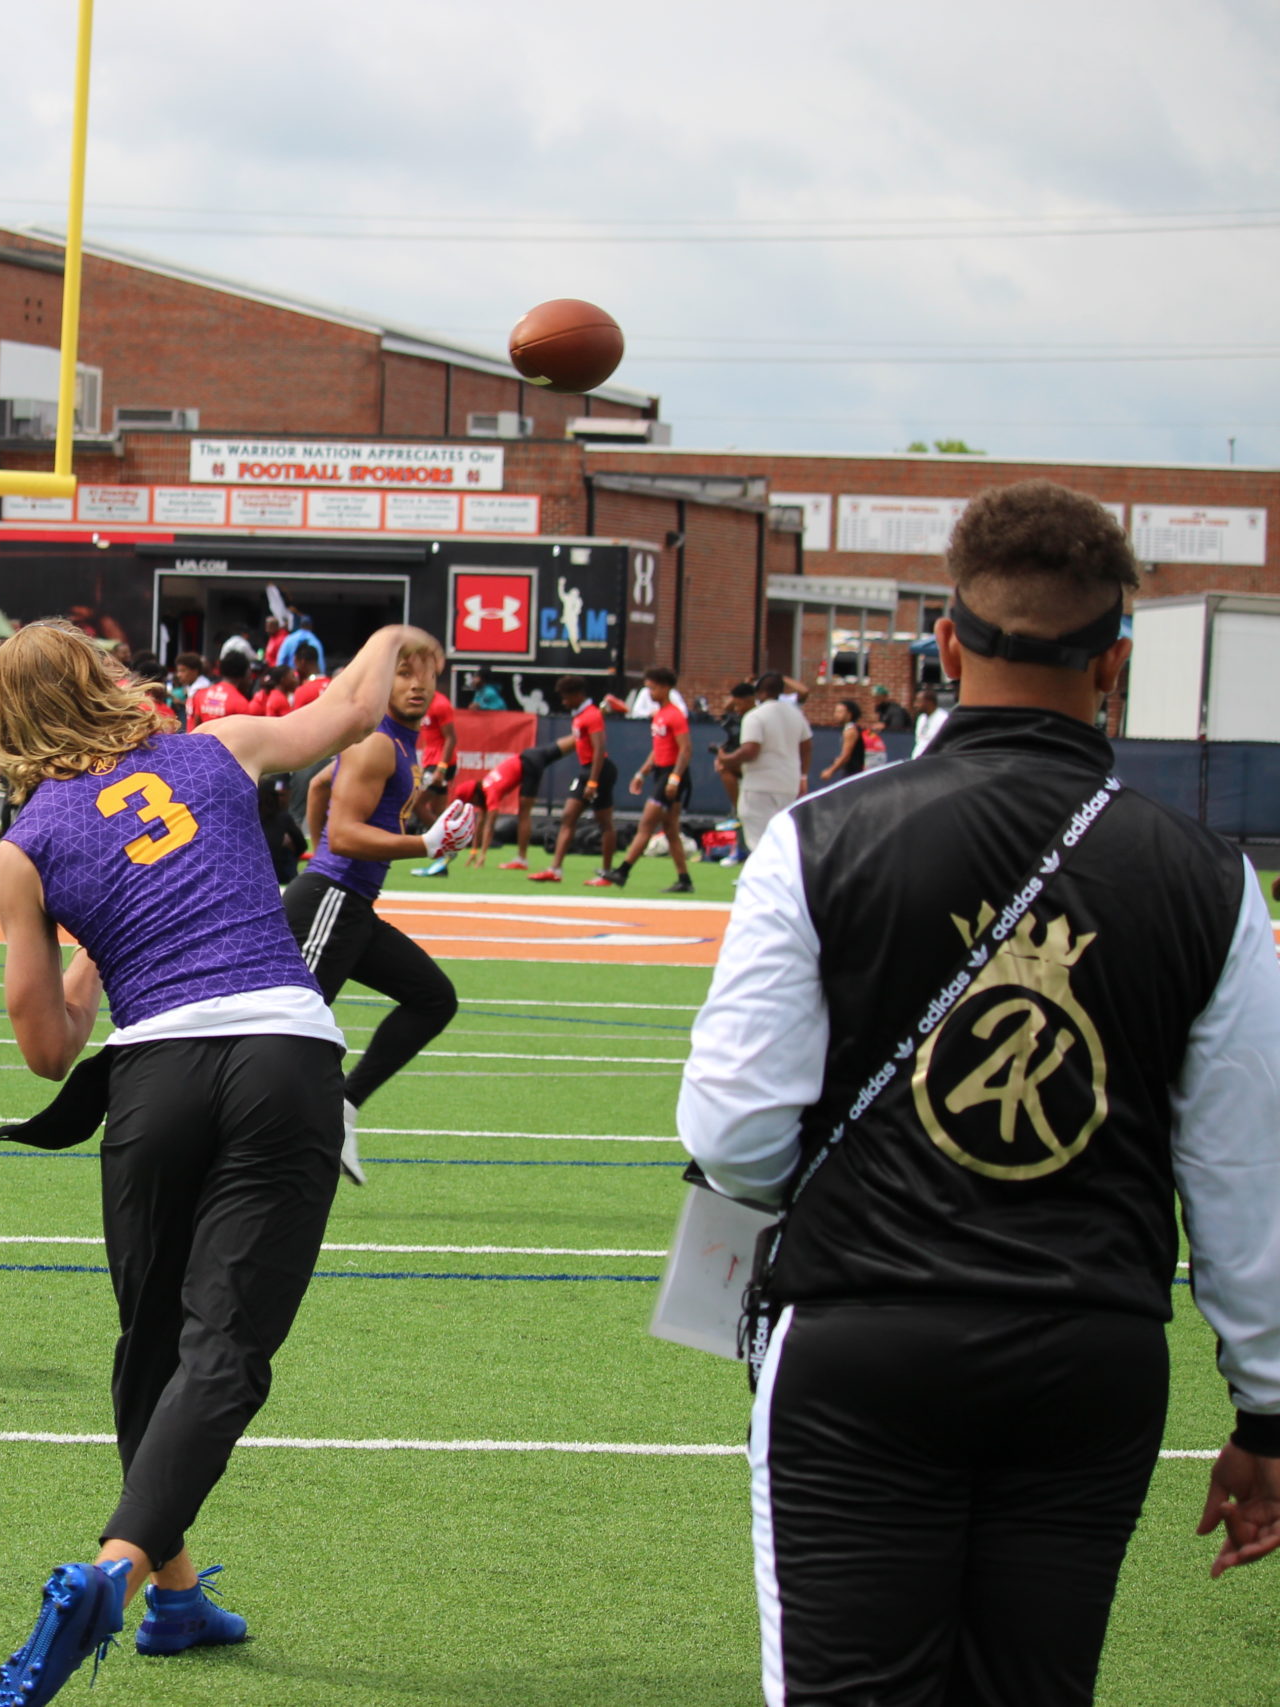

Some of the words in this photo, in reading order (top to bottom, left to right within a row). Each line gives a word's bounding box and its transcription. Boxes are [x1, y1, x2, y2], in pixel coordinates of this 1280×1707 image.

[199, 444, 221, 456] The
[227, 445, 297, 458] WARRIOR
[302, 447, 361, 459] NATION
[367, 448, 463, 462] APPRECIATES
[469, 451, 495, 463] Our
[237, 461, 341, 481] FOOTBALL
[348, 465, 454, 484] SPONSORS
[95, 771, 200, 866] 3
[1062, 789, 1111, 847] adidas
[991, 876, 1044, 940] adidas
[918, 971, 971, 1034] adidas
[849, 1061, 897, 1121] adidas
